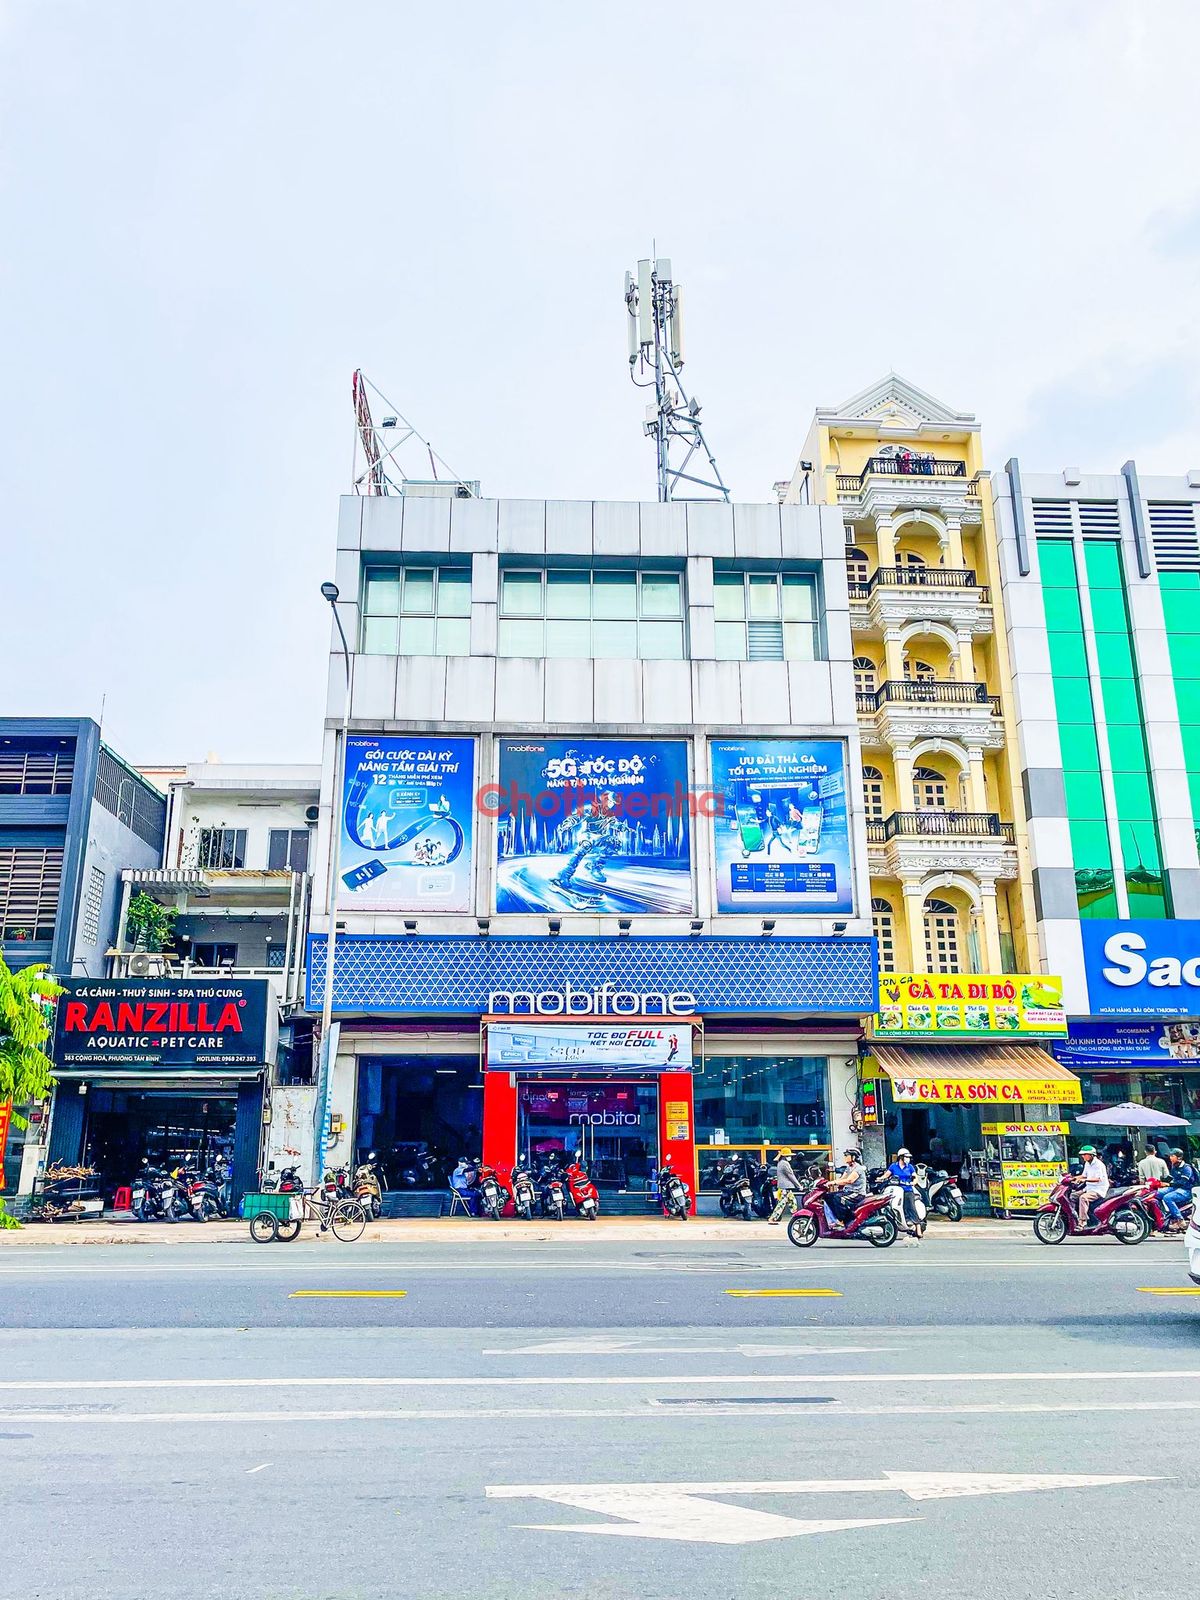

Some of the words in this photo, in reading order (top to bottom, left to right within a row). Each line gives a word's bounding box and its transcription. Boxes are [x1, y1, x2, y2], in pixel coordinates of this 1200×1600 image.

[365, 749, 384, 760] GÓI
[386, 749, 416, 760] CƯỚC
[417, 750, 436, 761] DÀI
[438, 751, 453, 761] KỲ
[777, 753, 798, 764] THẢ
[800, 755, 816, 763] GA
[358, 761, 389, 771] NÂNG
[416, 762, 438, 772] GIẢI
[440, 762, 460, 773] TRÍ
[547, 758, 577, 778] 5G
[728, 766, 745, 775] TỐI
[746, 767, 761, 775] ĐA
[763, 765, 786, 774] TRẢI
[788, 764, 828, 774] NGHIỆM
[372, 774, 386, 785] 12
[900, 976, 913, 984] CA
[76, 987, 88, 997] CÁ
[90, 987, 116, 997] CẢNH
[148, 988, 170, 998] SINH
[177, 989, 195, 998] SPA
[196, 987, 215, 998] THÚ
[908, 980, 935, 999] GÀ
[939, 983, 965, 999] TA
[968, 983, 988, 999] ĐI
[992, 980, 1017, 1003] BỘ
[488, 982, 697, 1016] mobifone
[65, 1002, 243, 1033] RANZILLA
[627, 1031, 664, 1039] FULL
[1123, 1037, 1134, 1045] TÀI
[87, 1036, 149, 1049] AQUATIC
[161, 1037, 185, 1048] PET
[187, 1037, 224, 1048] CARE
[919, 1080, 940, 1099] GÀ
[944, 1085, 964, 1099] TA
[968, 1083, 999, 1099] SƠN
[1001, 1084, 1023, 1099] CA
